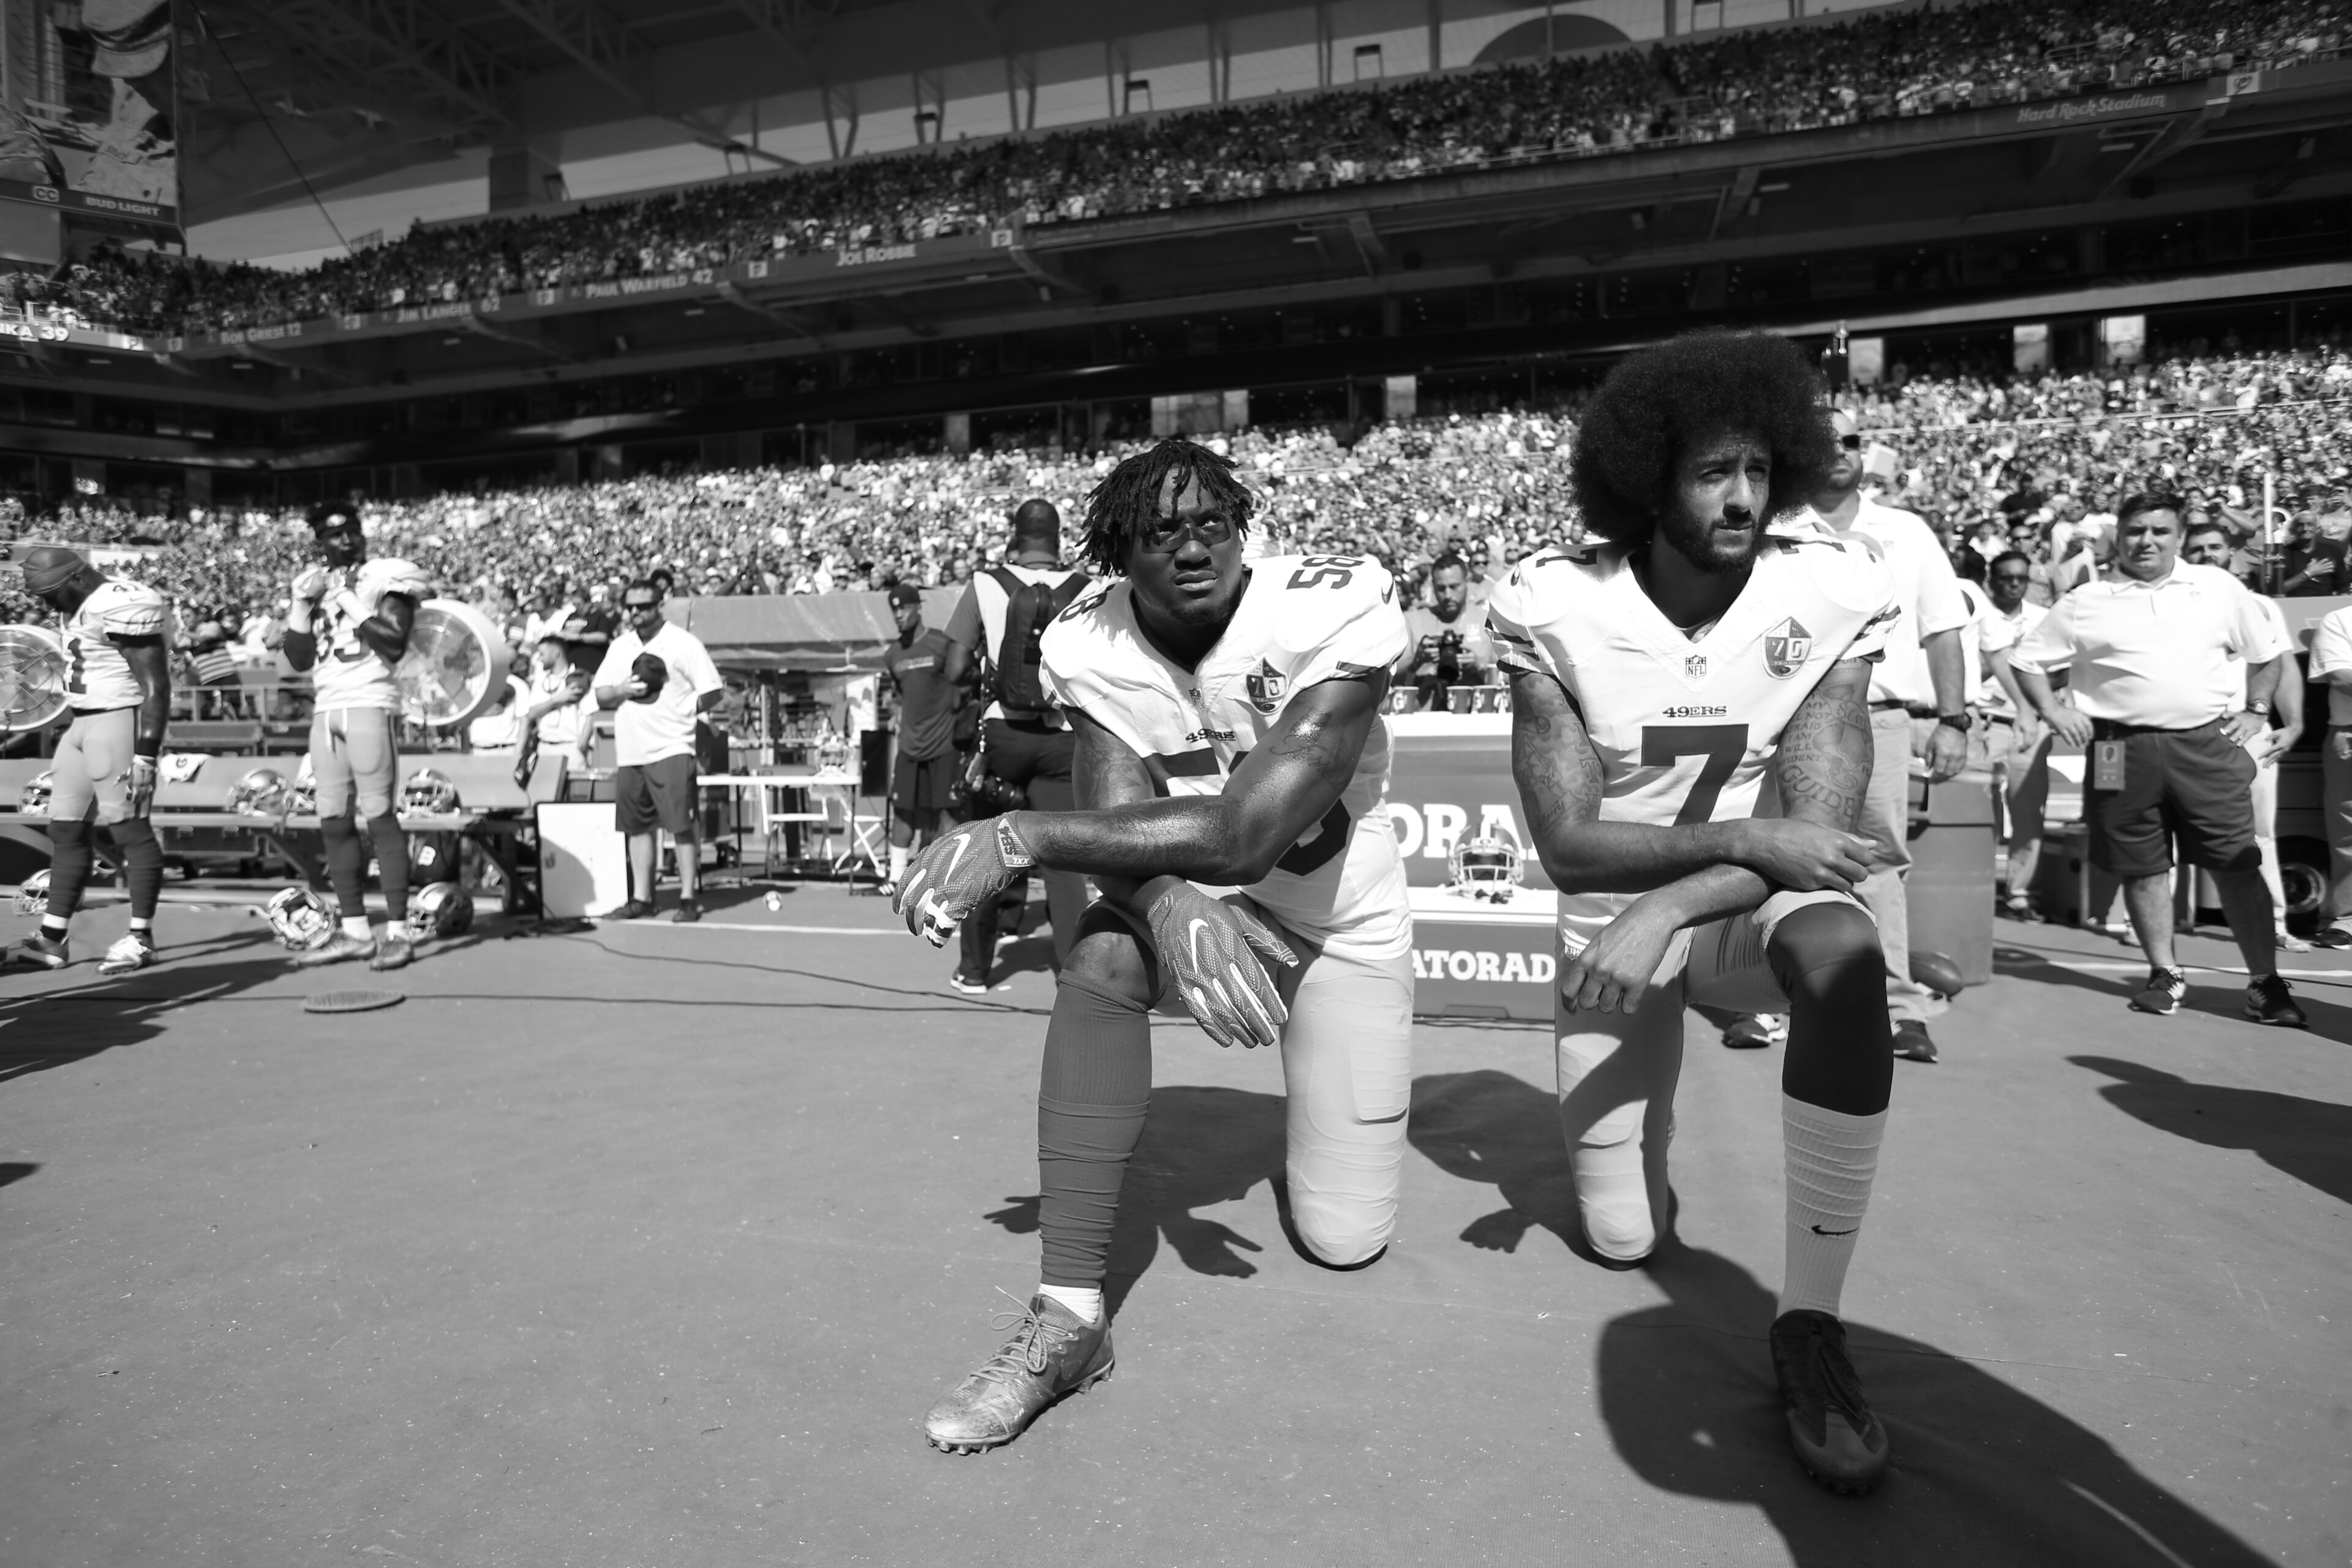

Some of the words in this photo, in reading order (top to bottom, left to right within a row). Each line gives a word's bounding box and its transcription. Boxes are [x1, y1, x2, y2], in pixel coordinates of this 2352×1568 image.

[2017, 104, 2057, 122] Hard
[2059, 101, 2096, 120] Rock
[2097, 94, 2165, 112] Stadium
[35, 187, 58, 201] CC
[86, 197, 118, 209] BUD
[118, 202, 160, 216] LIGHT
[585, 282, 619, 299] PAUL
[620, 273, 688, 295] WARFIELD
[692, 268, 714, 285] 42
[481, 296, 500, 313] 62
[40, 325, 70, 342] 39
[287, 322, 301, 337] 12
[1286, 556, 1366, 590] 58
[1687, 665, 1705, 676] NFL
[1662, 706, 1728, 718] 49ERS
[1807, 711, 1830, 720] NOT
[1185, 728, 1237, 744] 49ERS
[1793, 733, 1811, 742] AM
[1785, 744, 1812, 753] WILL
[1641, 723, 1749, 827] 7
[1412, 949, 1556, 984] ATORAD
